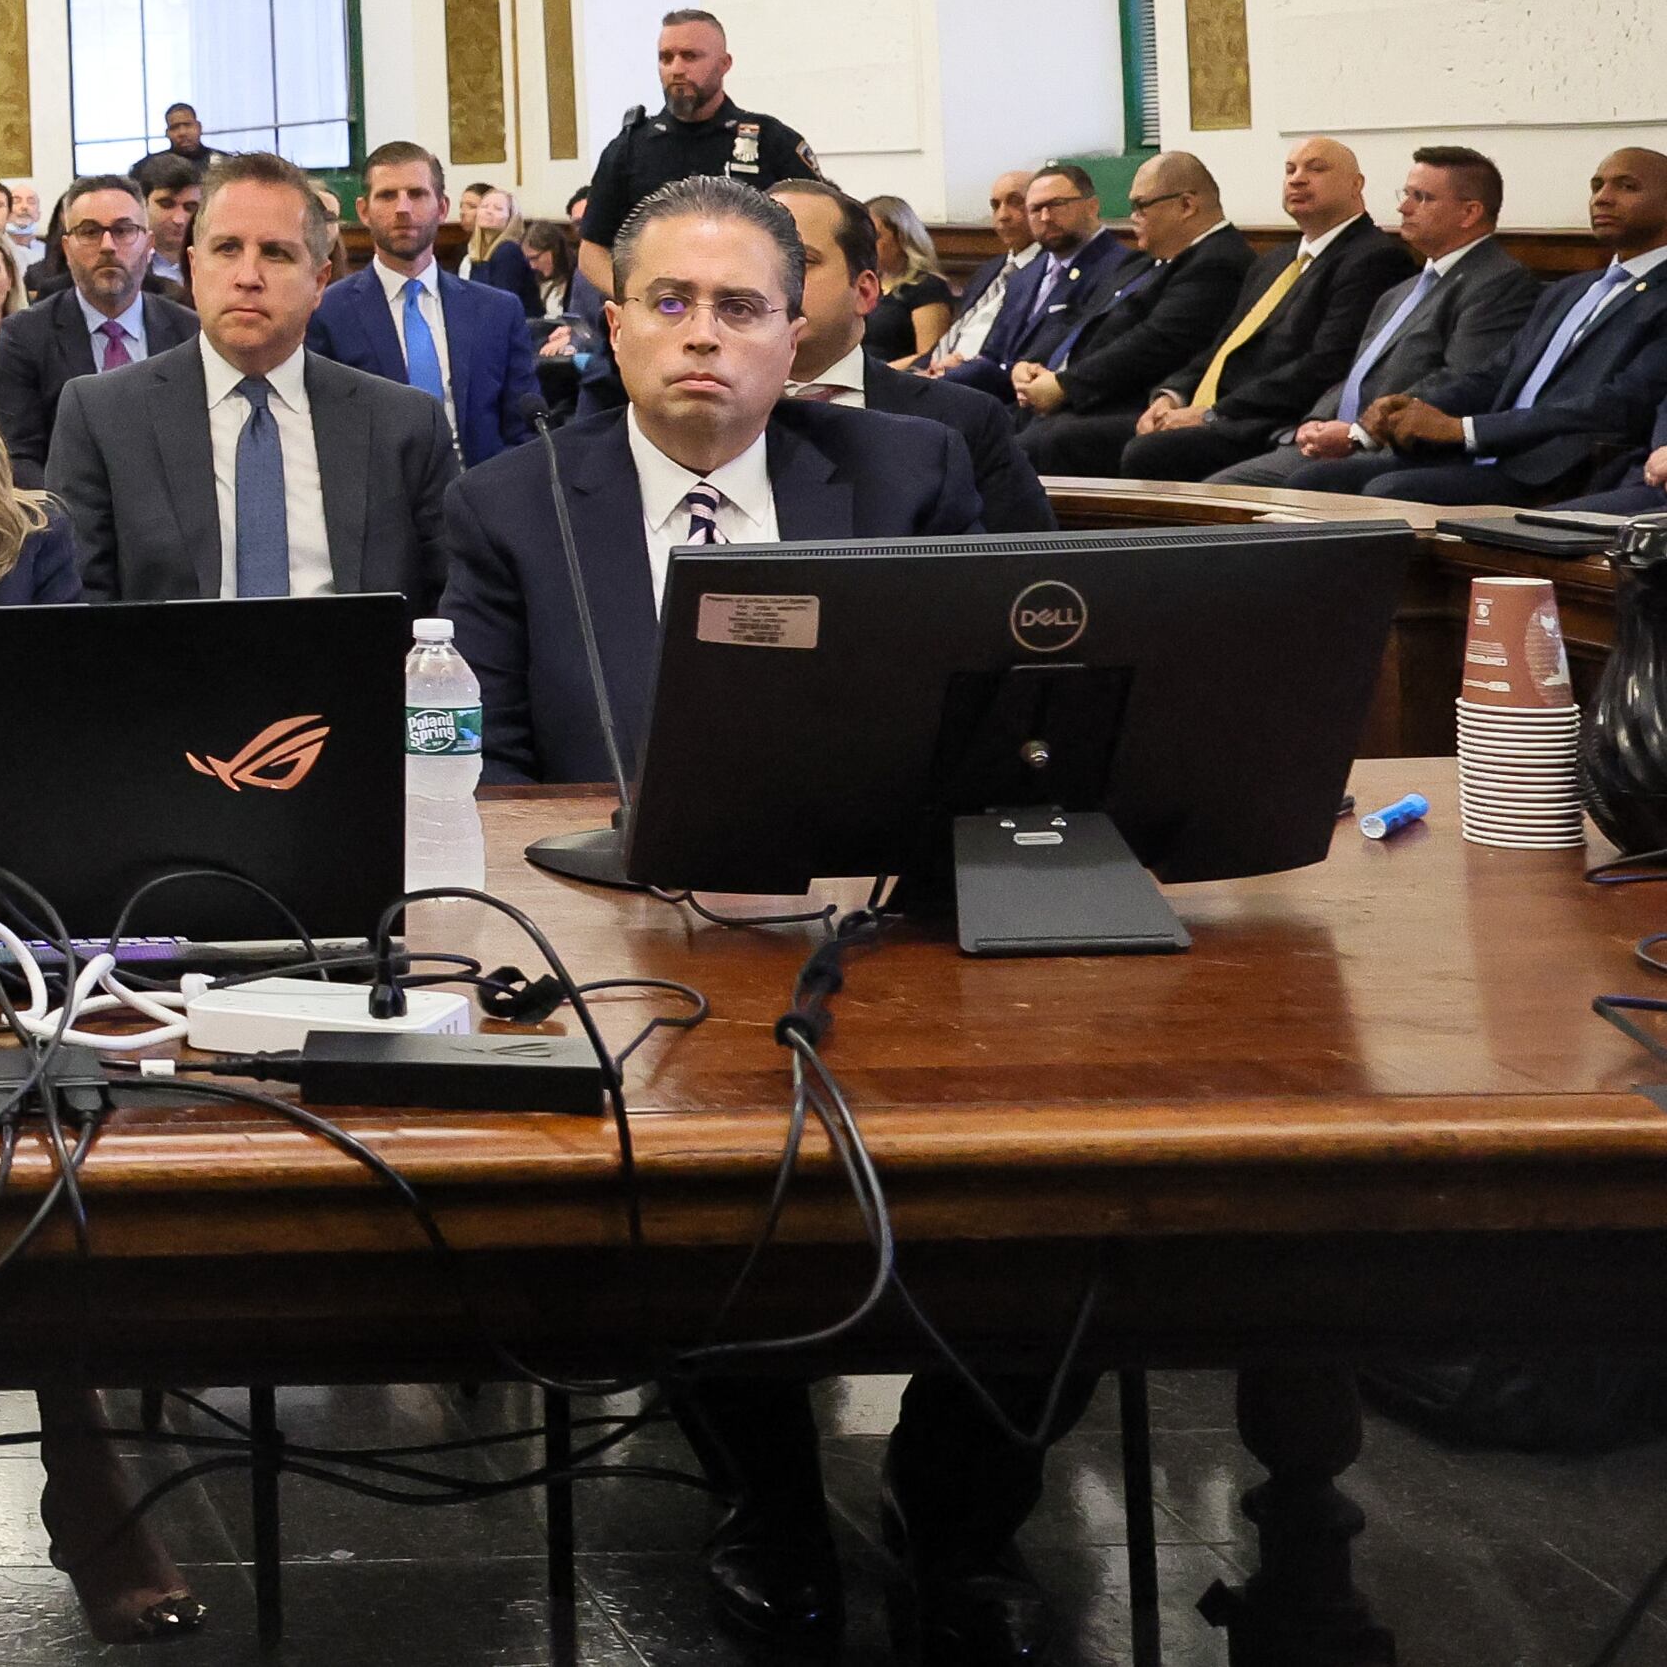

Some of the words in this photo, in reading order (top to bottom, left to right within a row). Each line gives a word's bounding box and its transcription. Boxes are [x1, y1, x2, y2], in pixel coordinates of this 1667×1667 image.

[1021, 607, 1079, 627] DELL
[407, 711, 455, 733] Poland
[409, 726, 456, 747] Spring
